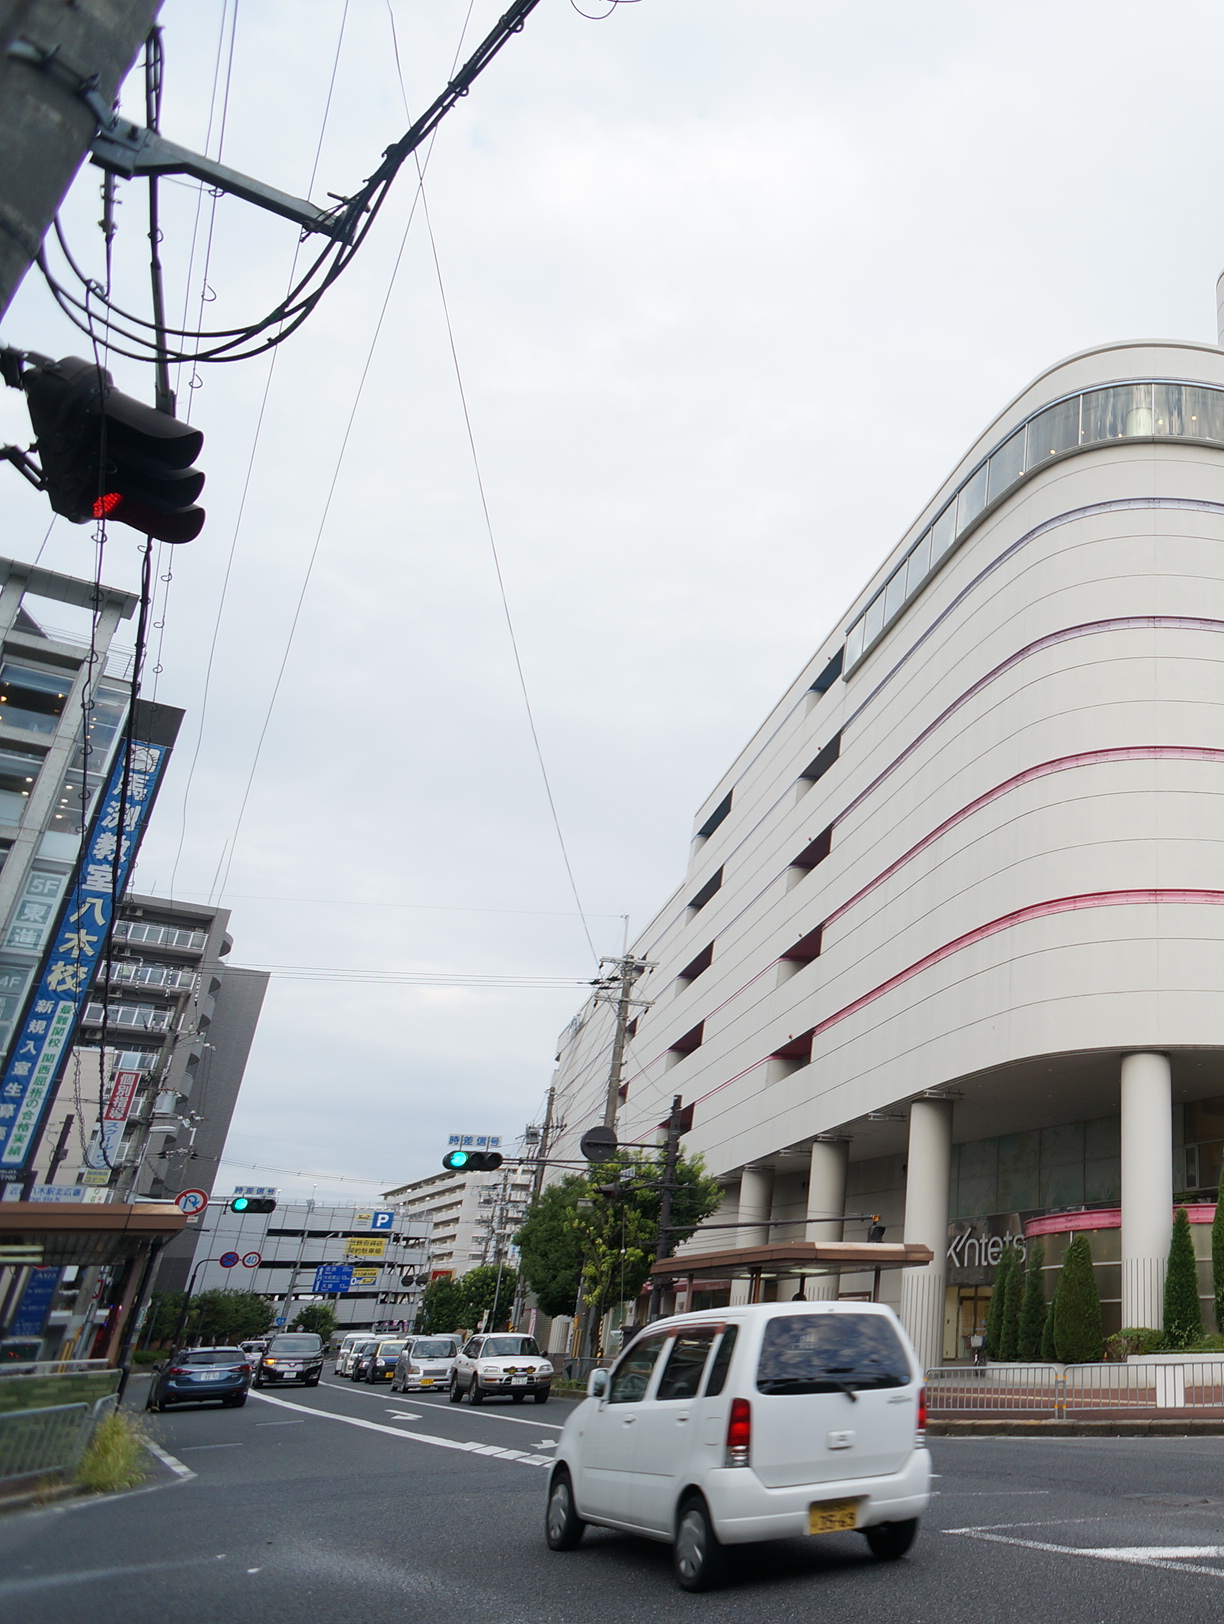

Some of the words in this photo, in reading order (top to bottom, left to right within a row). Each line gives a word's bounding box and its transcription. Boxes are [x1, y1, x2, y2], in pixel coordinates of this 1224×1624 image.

[30, 878, 60, 894] 5F
[14, 903, 48, 949] 東進
[109, 1073, 136, 1120] 個別指導
[449, 1135, 500, 1146] 時差信号
[234, 1186, 276, 1196] 時差信号
[376, 1214, 389, 1227] P
[246, 1255, 257, 1264] 40
